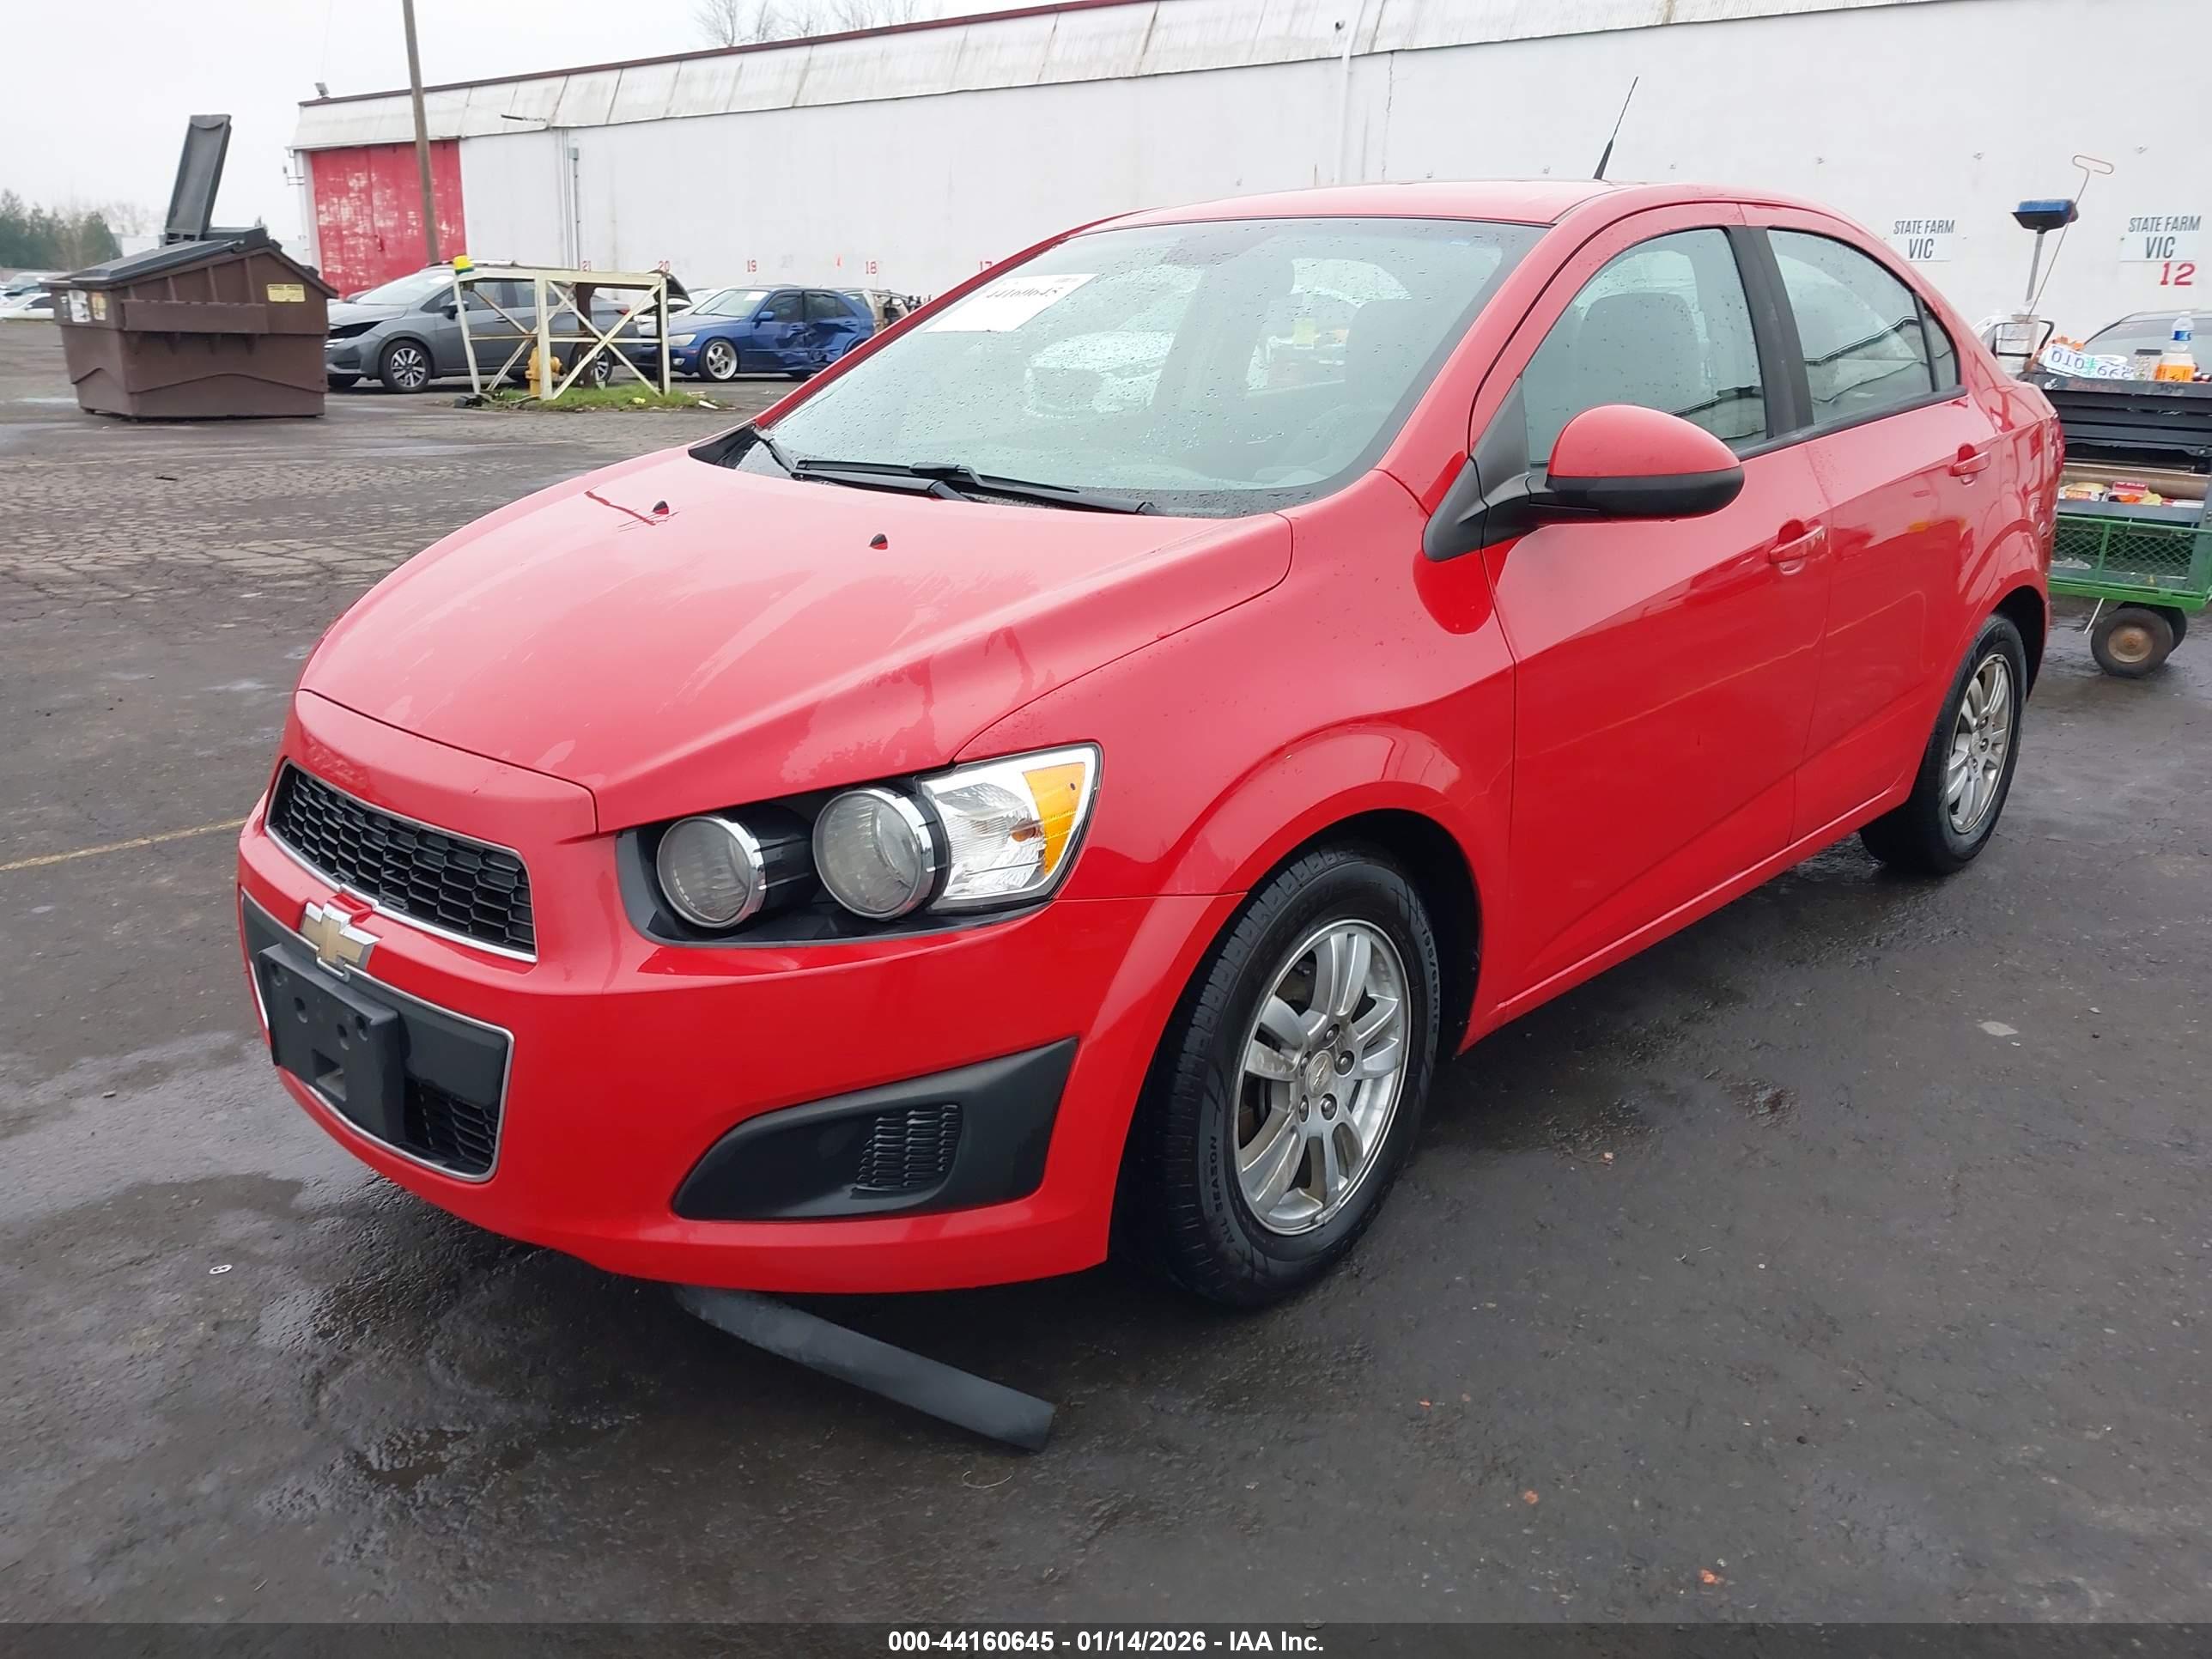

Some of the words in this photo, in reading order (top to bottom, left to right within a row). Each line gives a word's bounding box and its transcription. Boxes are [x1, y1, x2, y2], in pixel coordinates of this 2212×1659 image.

[1893, 220, 1923, 234] STATE
[1923, 219, 1955, 234] FARM
[2128, 217, 2162, 232] STATE
[2164, 216, 2201, 231] FARM
[1909, 238, 1934, 258] VIC
[2146, 236, 2175, 258] VIC
[746, 259, 757, 273] 19
[865, 260, 878, 275] 18
[2160, 262, 2195, 286] 12
[1209, 1135, 1224, 1212] SEASON
